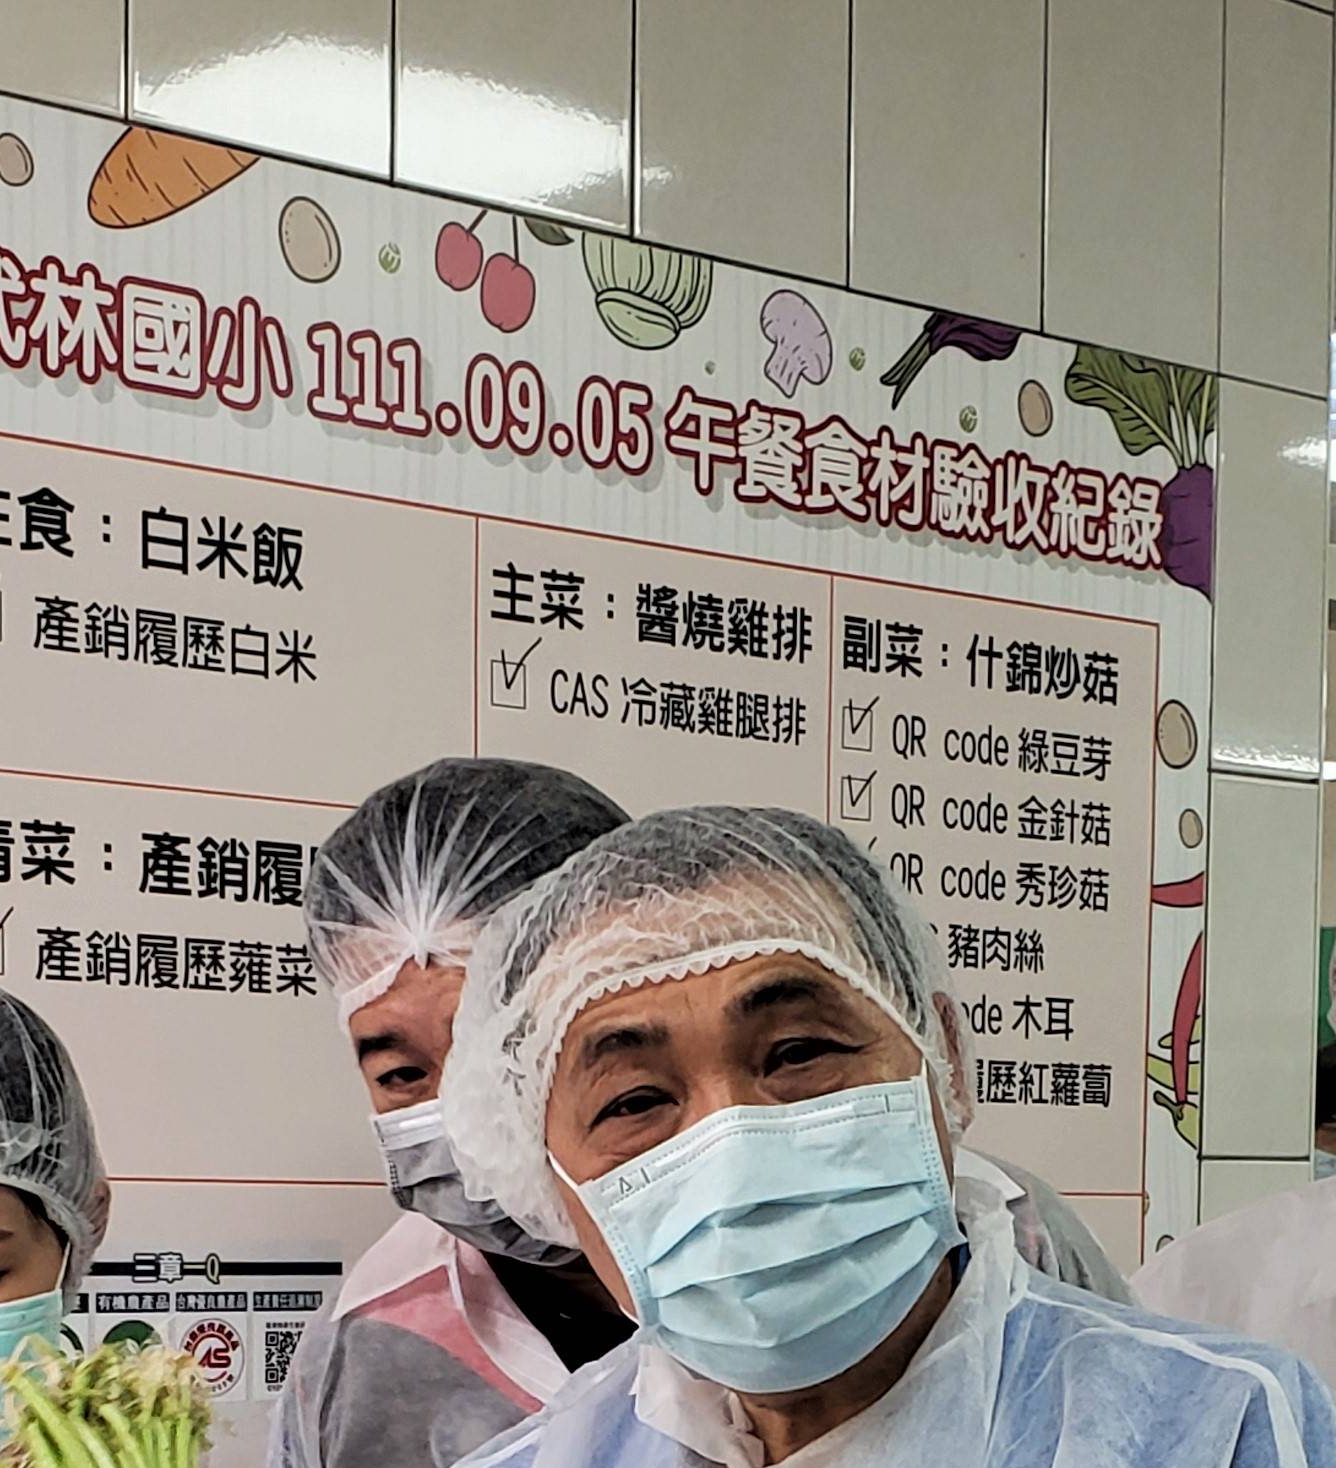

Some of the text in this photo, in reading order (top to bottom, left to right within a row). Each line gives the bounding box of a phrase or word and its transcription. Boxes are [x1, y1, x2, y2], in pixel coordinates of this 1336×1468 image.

[306, 321, 653, 477] 111.09.05
[665, 385, 1164, 571] 午餐食材驗收紀錄
[32, 595, 318, 684] 產銷履歷白米
[550, 670, 807, 747] CAS 冷藏雞腿排
[892, 714, 1112, 782] QR code 綠豆芽
[891, 784, 1111, 846] QR code 金針菇
[941, 860, 1006, 901] code
[1015, 862, 1109, 912] 秀珍菇
[35, 927, 318, 996] 產銷履歷蕹菜
[948, 923, 1044, 974] 豬肉絲
[961, 994, 1075, 1041] de 木耳
